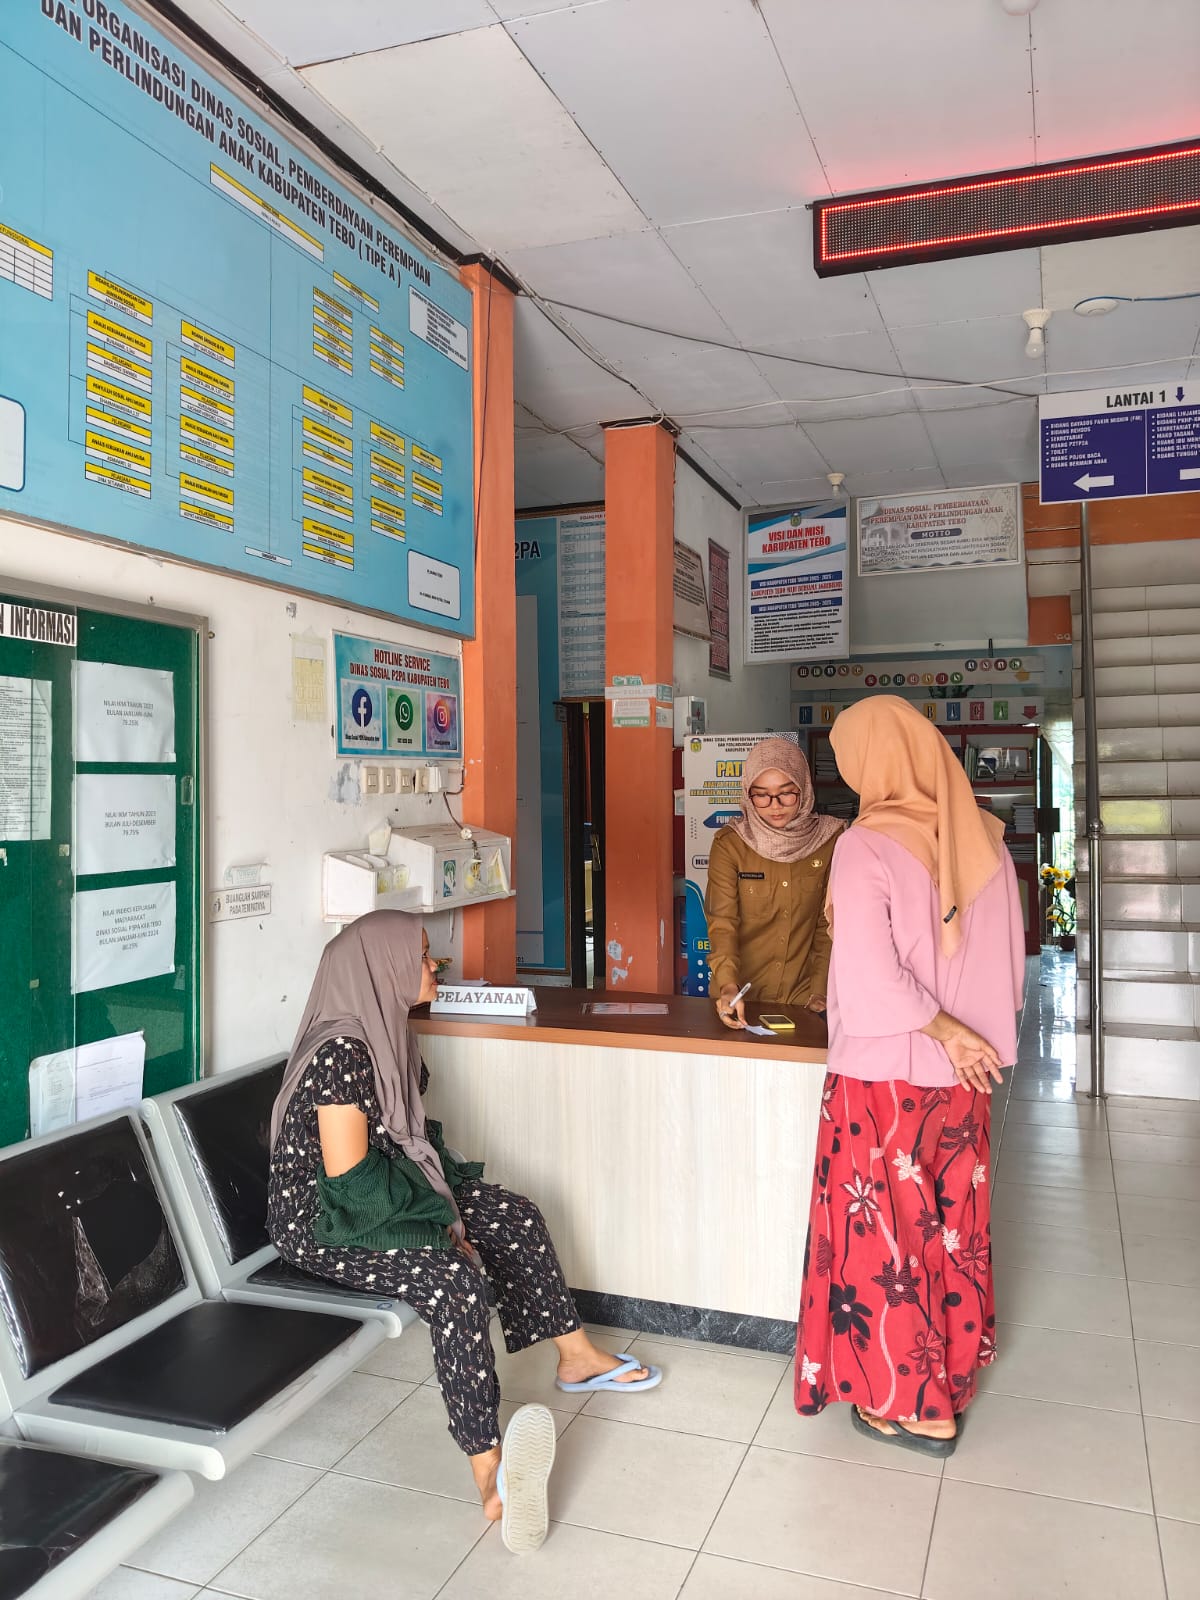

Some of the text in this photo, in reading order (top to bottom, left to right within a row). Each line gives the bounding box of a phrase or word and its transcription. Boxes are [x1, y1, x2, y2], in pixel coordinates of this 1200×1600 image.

[41, 0, 82, 42] DAN
[89, 26, 215, 143] PERLINDUNGAN
[219, 132, 254, 174] ANAK
[258, 159, 326, 228] KABUPATEN
[329, 214, 355, 250] TEBO
[365, 246, 386, 274] TIPE
[388, 264, 395, 281] A
[82, 0, 186, 92] ORGANISASI
[191, 78, 234, 130] DINAS
[237, 116, 285, 174] SOSIAL,
[288, 158, 374, 242] PEMBERDAYAAN
[376, 231, 431, 287] PEREMPUAN
[1106, 390, 1166, 408] LANTAI 1
[1157, 424, 1191, 432] SEKRETARIAT
[870, 514, 912, 524] PEREMPUAN
[929, 508, 982, 519] PERLINDUNGAN
[984, 505, 1004, 514] ANAK
[884, 506, 904, 515] DINAS
[934, 499, 989, 511] PEMBERDAYAAN
[906, 518, 966, 529] KABUPATEN TEBO
[768, 525, 824, 541] VISI DAN MISI
[921, 530, 951, 538] MOTTO
[762, 536, 831, 553] KABUPATEN TEBO
[10, 604, 75, 646] INFORMASI
[374, 648, 430, 672] HOTLINE SERVICE
[350, 663, 368, 677] DINAS
[370, 665, 390, 680] SOSIAL
[407, 672, 437, 688] KABUPATEN
[438, 677, 449, 689] TEBO
[436, 991, 526, 1004] PELAYANAN
